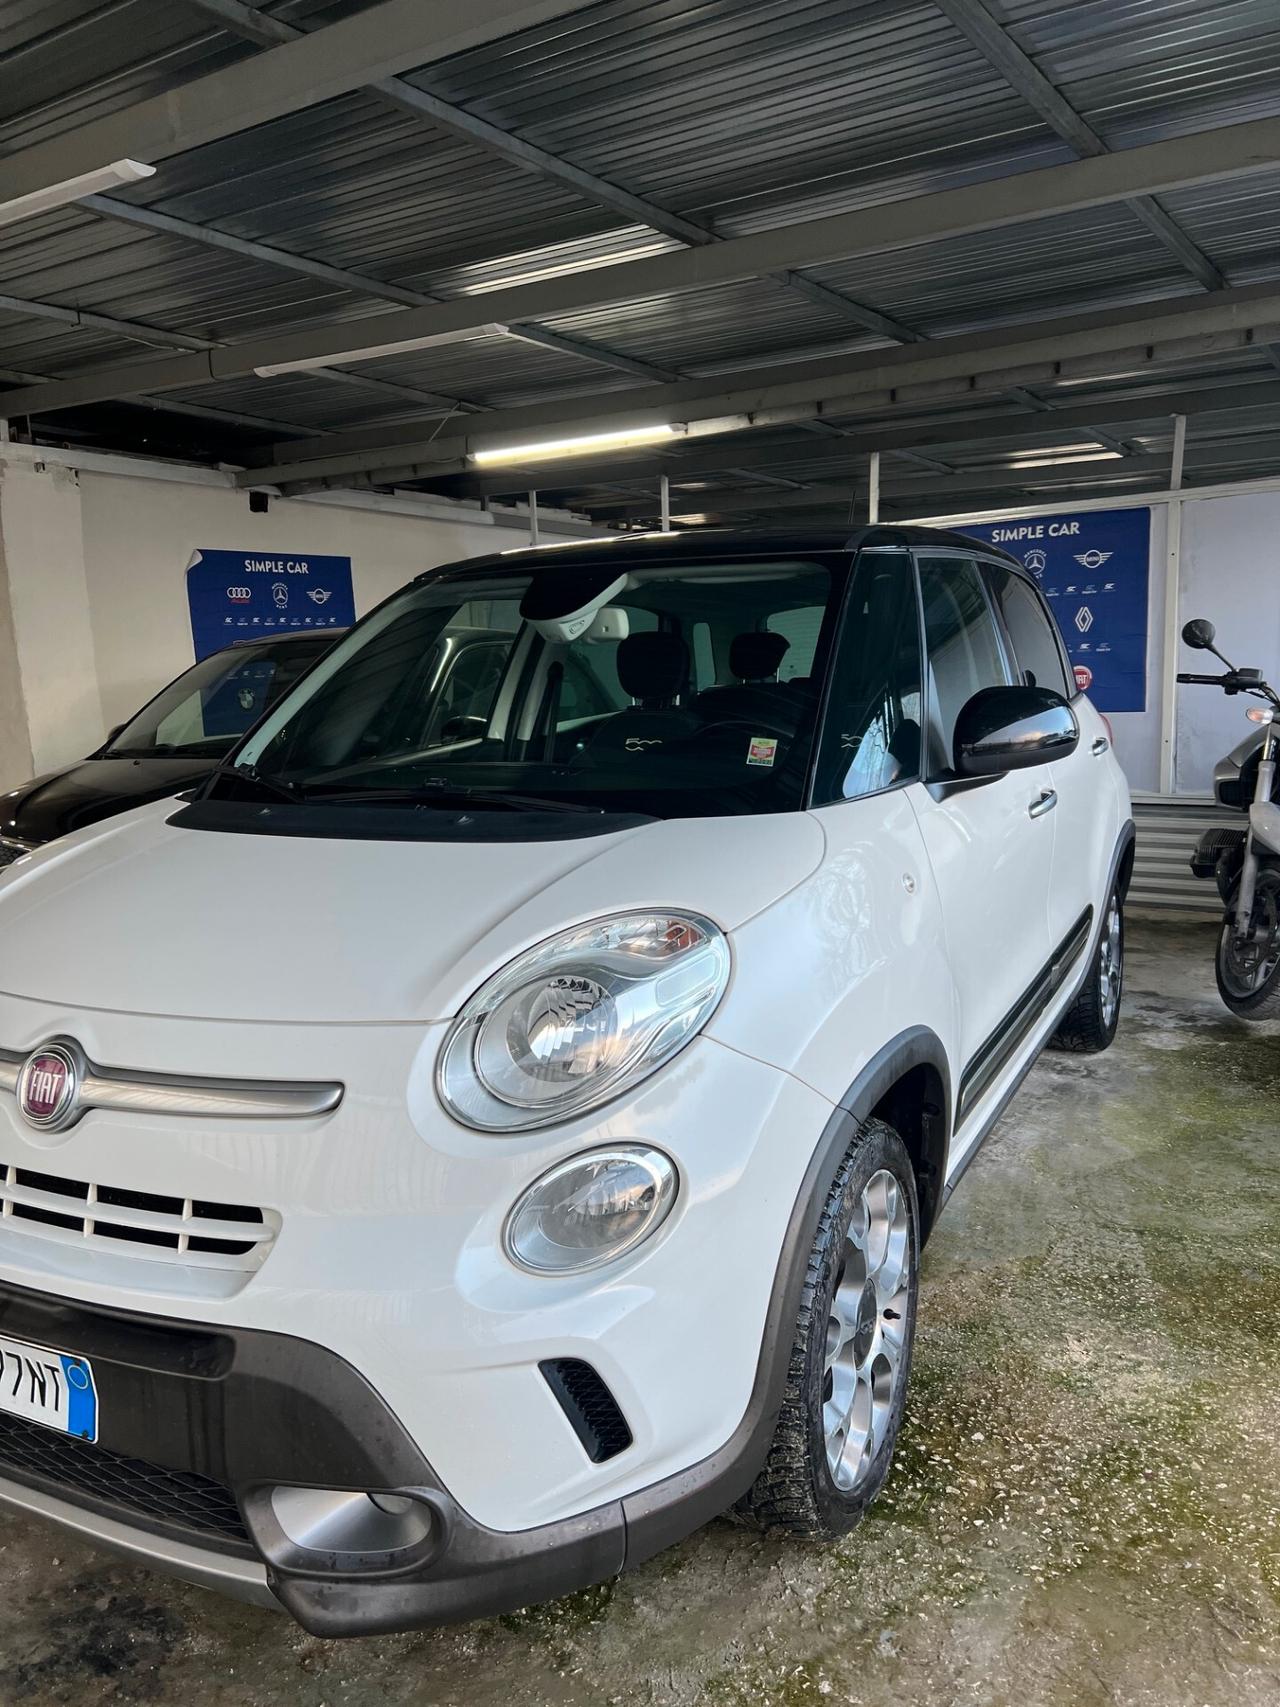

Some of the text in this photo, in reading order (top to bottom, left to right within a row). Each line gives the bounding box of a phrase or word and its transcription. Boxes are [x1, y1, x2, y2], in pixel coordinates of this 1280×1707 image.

[991, 522, 1080, 542] SIMPLE CAR
[244, 559, 309, 574] SIMPLE CAR
[28, 1070, 62, 1104] FIAT
